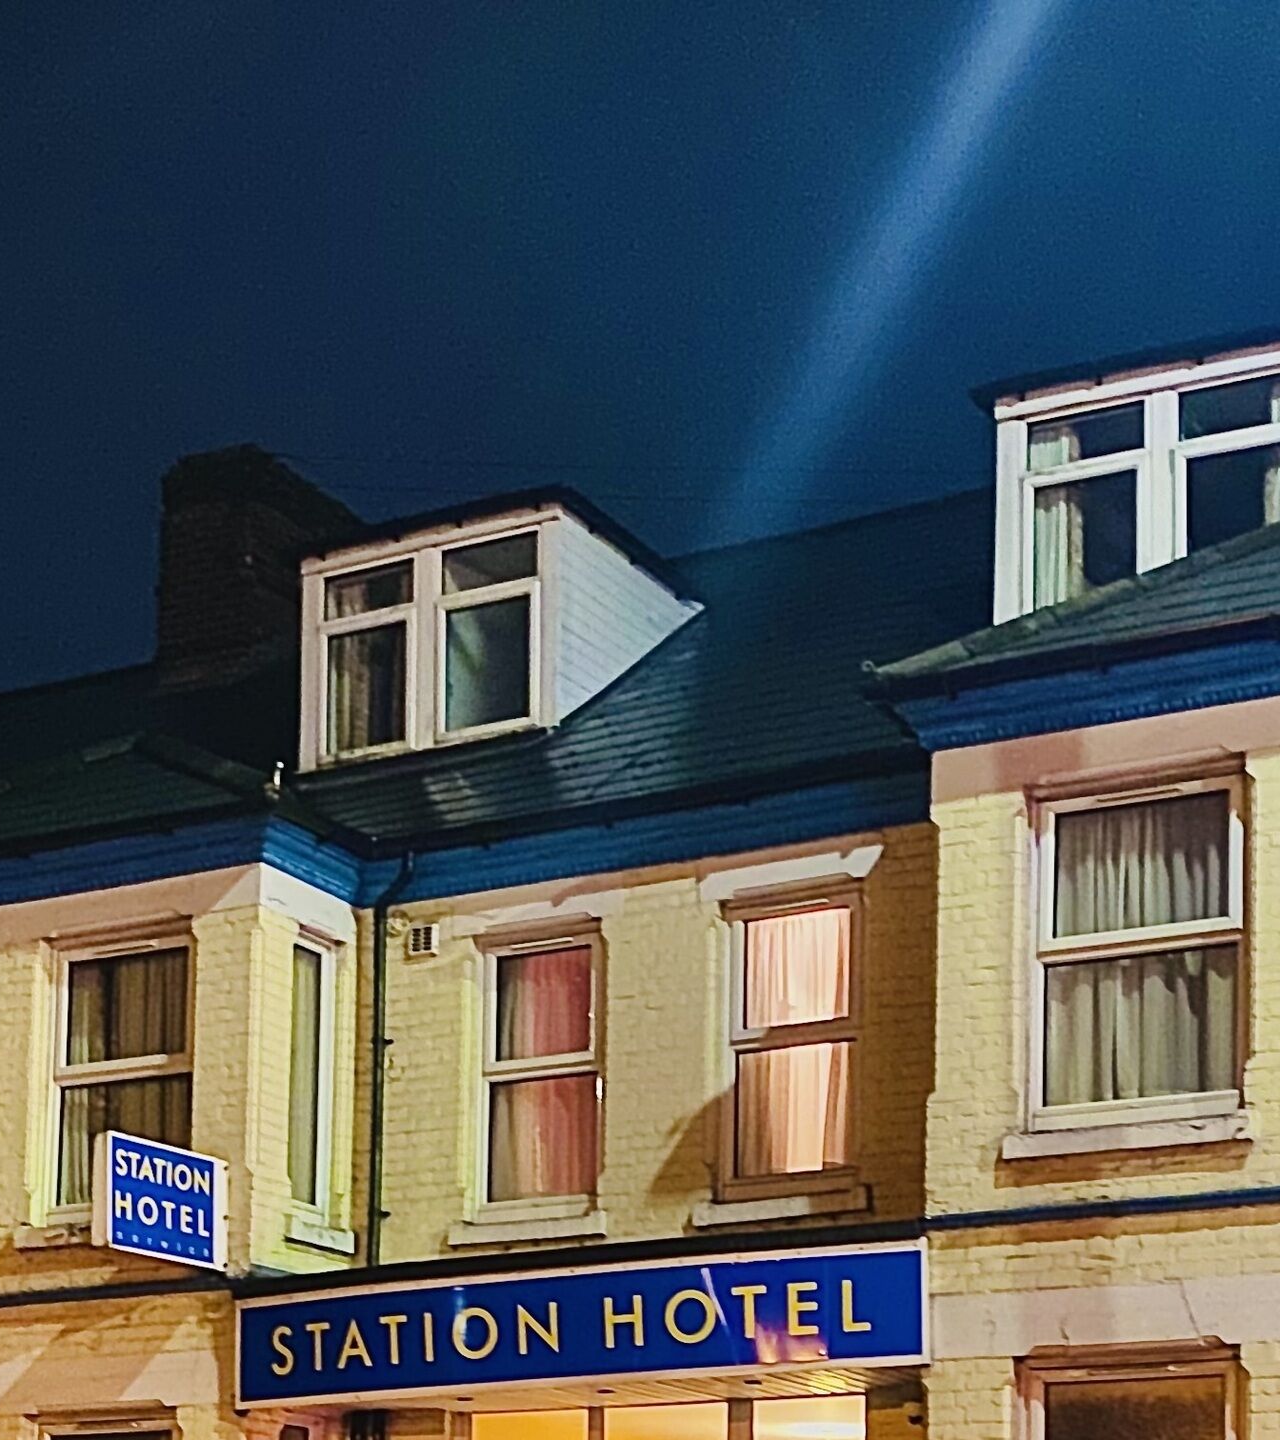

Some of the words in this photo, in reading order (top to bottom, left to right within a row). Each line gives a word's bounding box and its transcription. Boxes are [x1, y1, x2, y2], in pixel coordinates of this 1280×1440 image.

[114, 1148, 211, 1197] STATION
[114, 1189, 211, 1238] HOTEL
[271, 1301, 560, 1376] STATION
[602, 1279, 873, 1348] HOTEL
